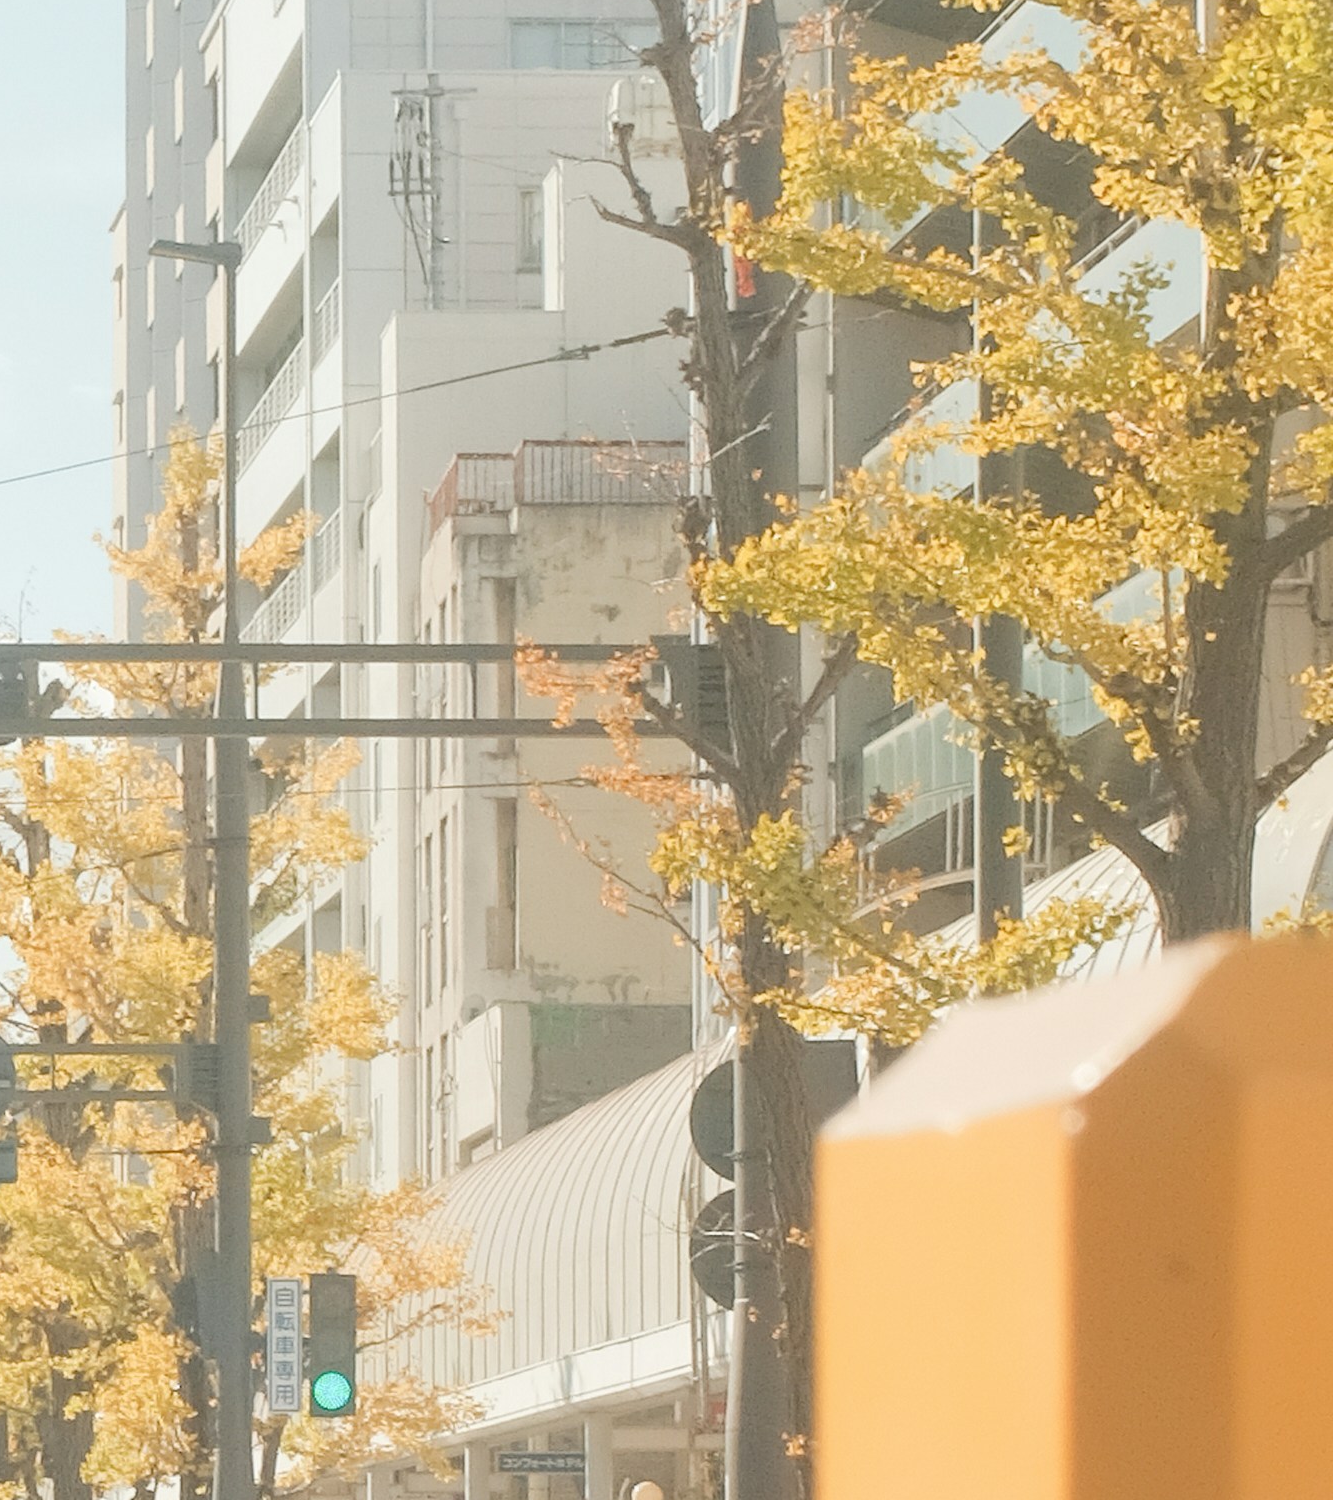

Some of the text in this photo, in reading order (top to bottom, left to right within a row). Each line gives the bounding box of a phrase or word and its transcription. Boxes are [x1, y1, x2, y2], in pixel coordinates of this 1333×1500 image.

[273, 1286, 296, 1406] 自転車専用
